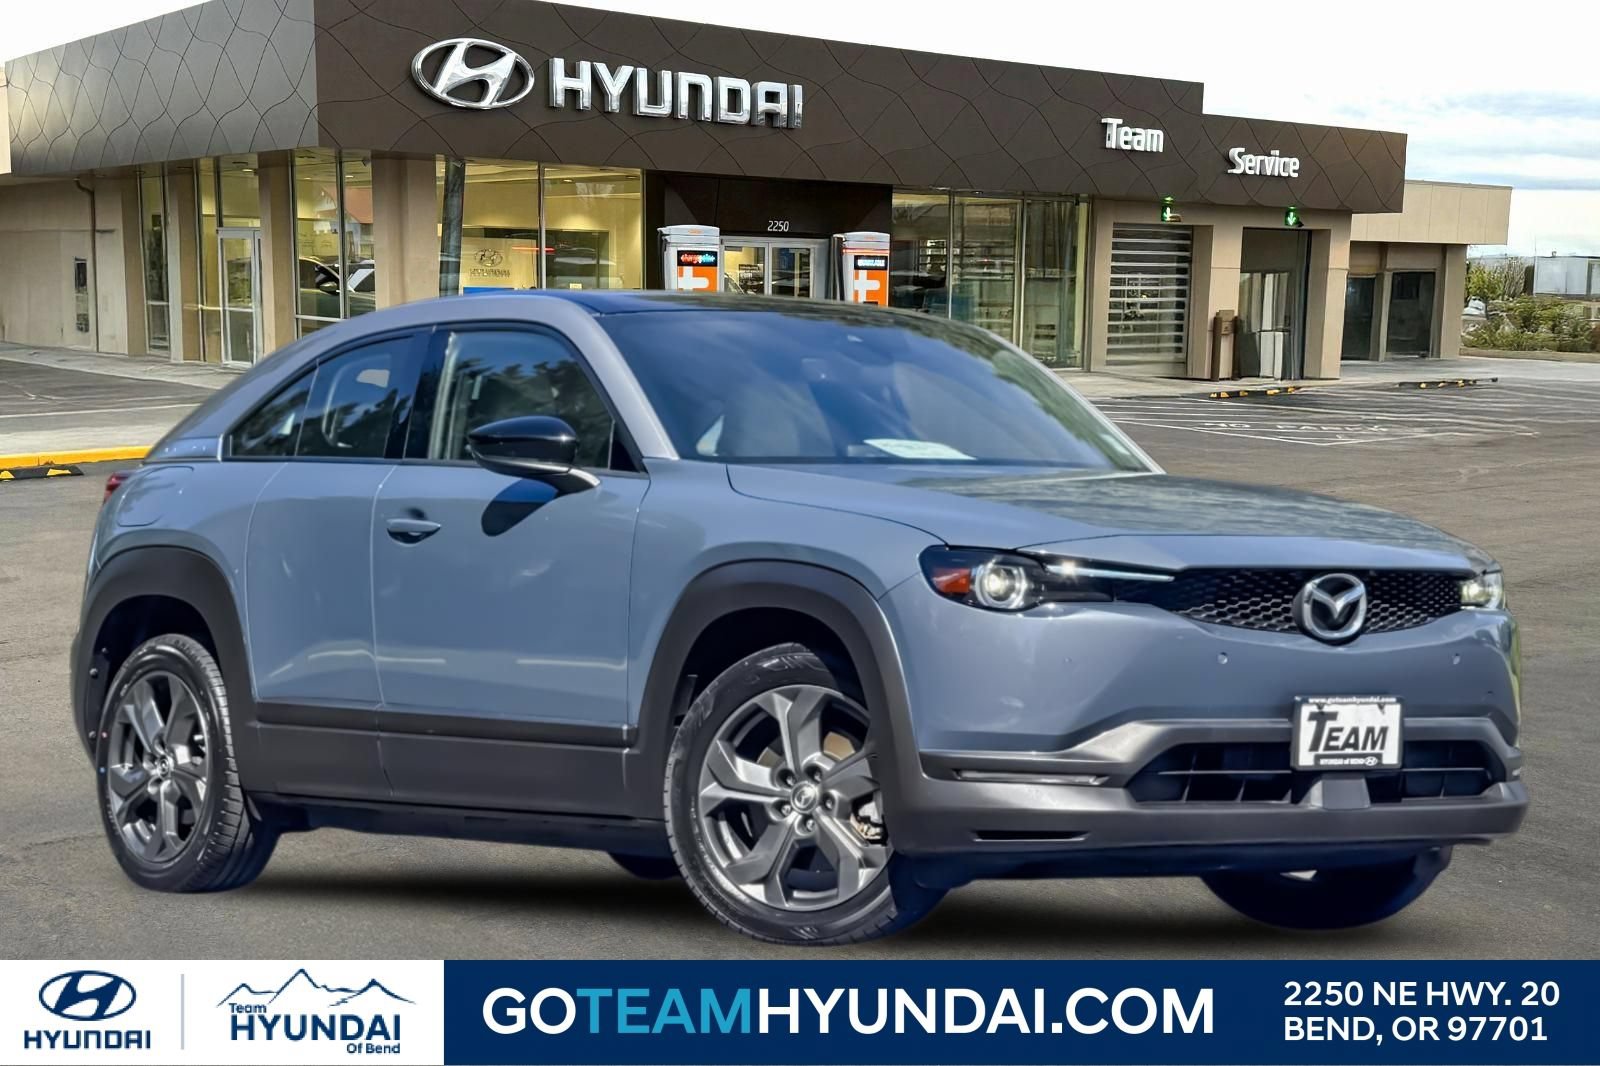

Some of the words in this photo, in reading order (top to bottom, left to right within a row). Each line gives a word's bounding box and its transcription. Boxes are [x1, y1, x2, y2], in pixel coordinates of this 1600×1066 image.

[548, 57, 804, 129] HYUNDAI
[1101, 117, 1164, 153] Team
[1227, 147, 1300, 178] Service
[767, 220, 790, 232] 2250
[1307, 711, 1389, 752] TEAM
